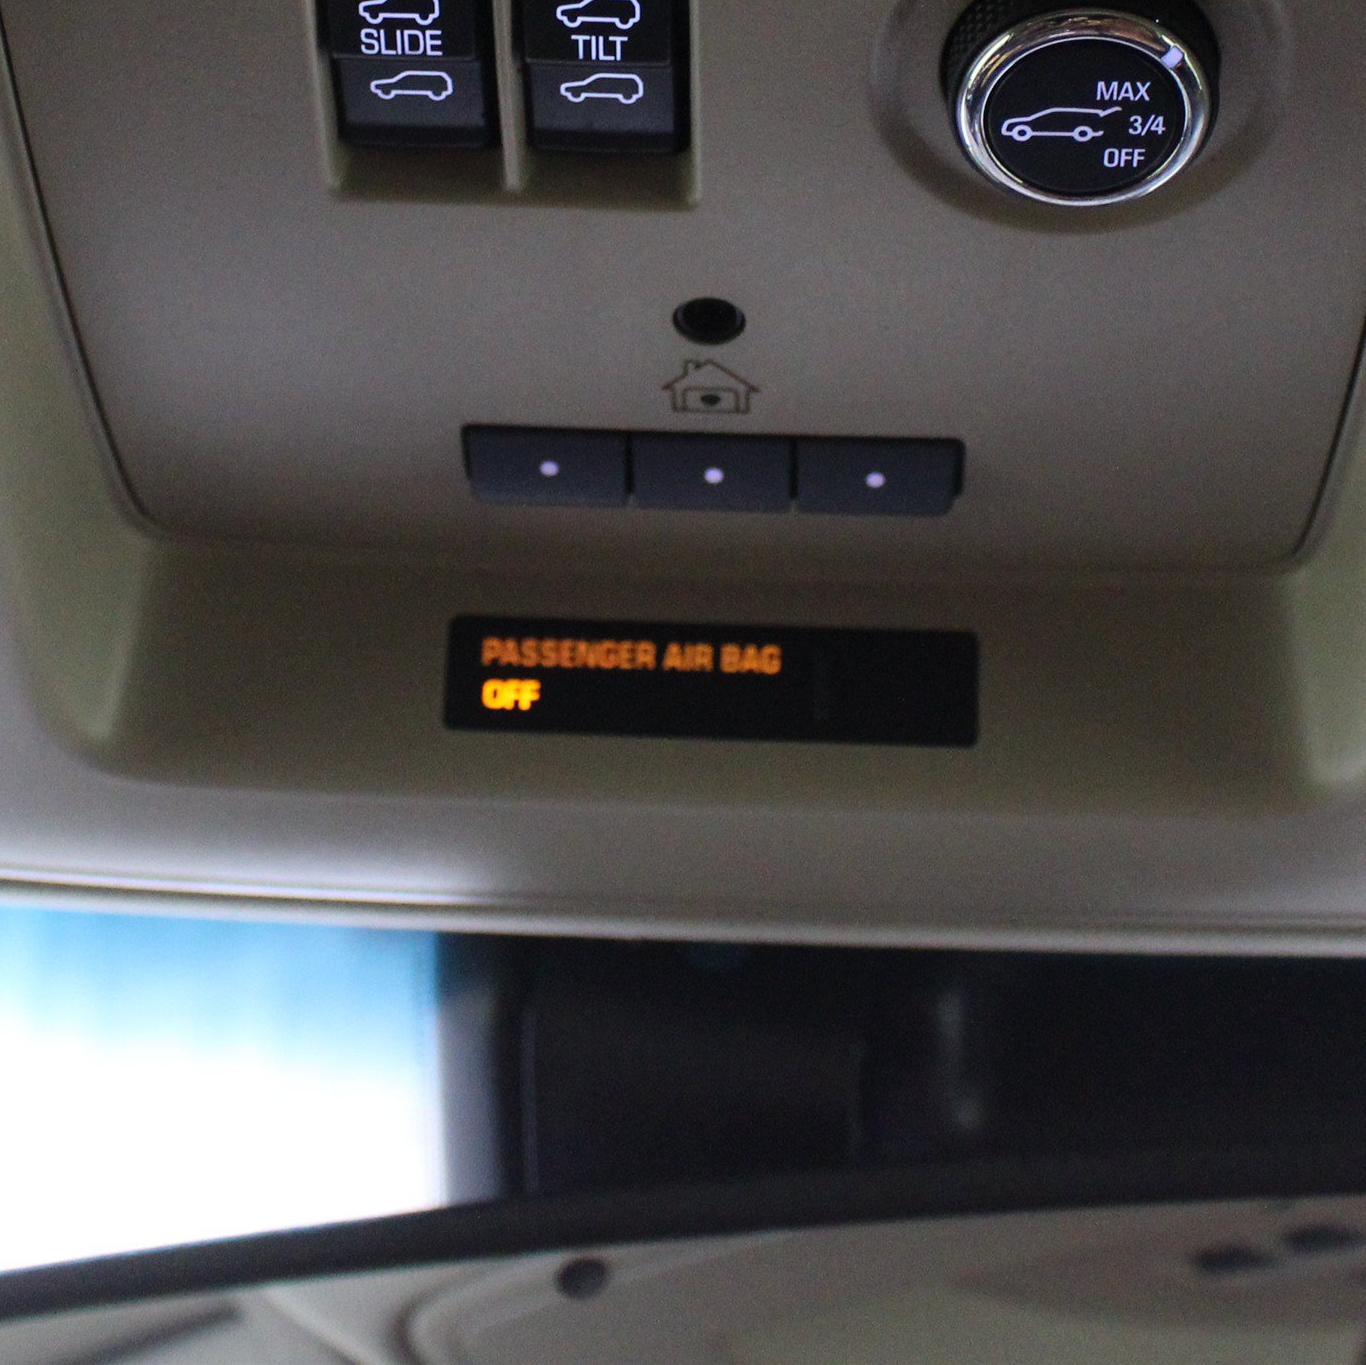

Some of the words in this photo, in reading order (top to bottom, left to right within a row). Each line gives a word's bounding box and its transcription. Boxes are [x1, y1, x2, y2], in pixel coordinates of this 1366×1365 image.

[360, 27, 443, 57] SLIDE
[570, 34, 629, 62] TILT
[1096, 80, 1151, 102] MAX
[1128, 114, 1166, 137] 3/4
[1103, 147, 1146, 168] OFF
[481, 637, 656, 671] PASSENGER
[663, 642, 714, 672] AIR
[720, 644, 782, 675] BAG
[481, 678, 541, 711] OFF
